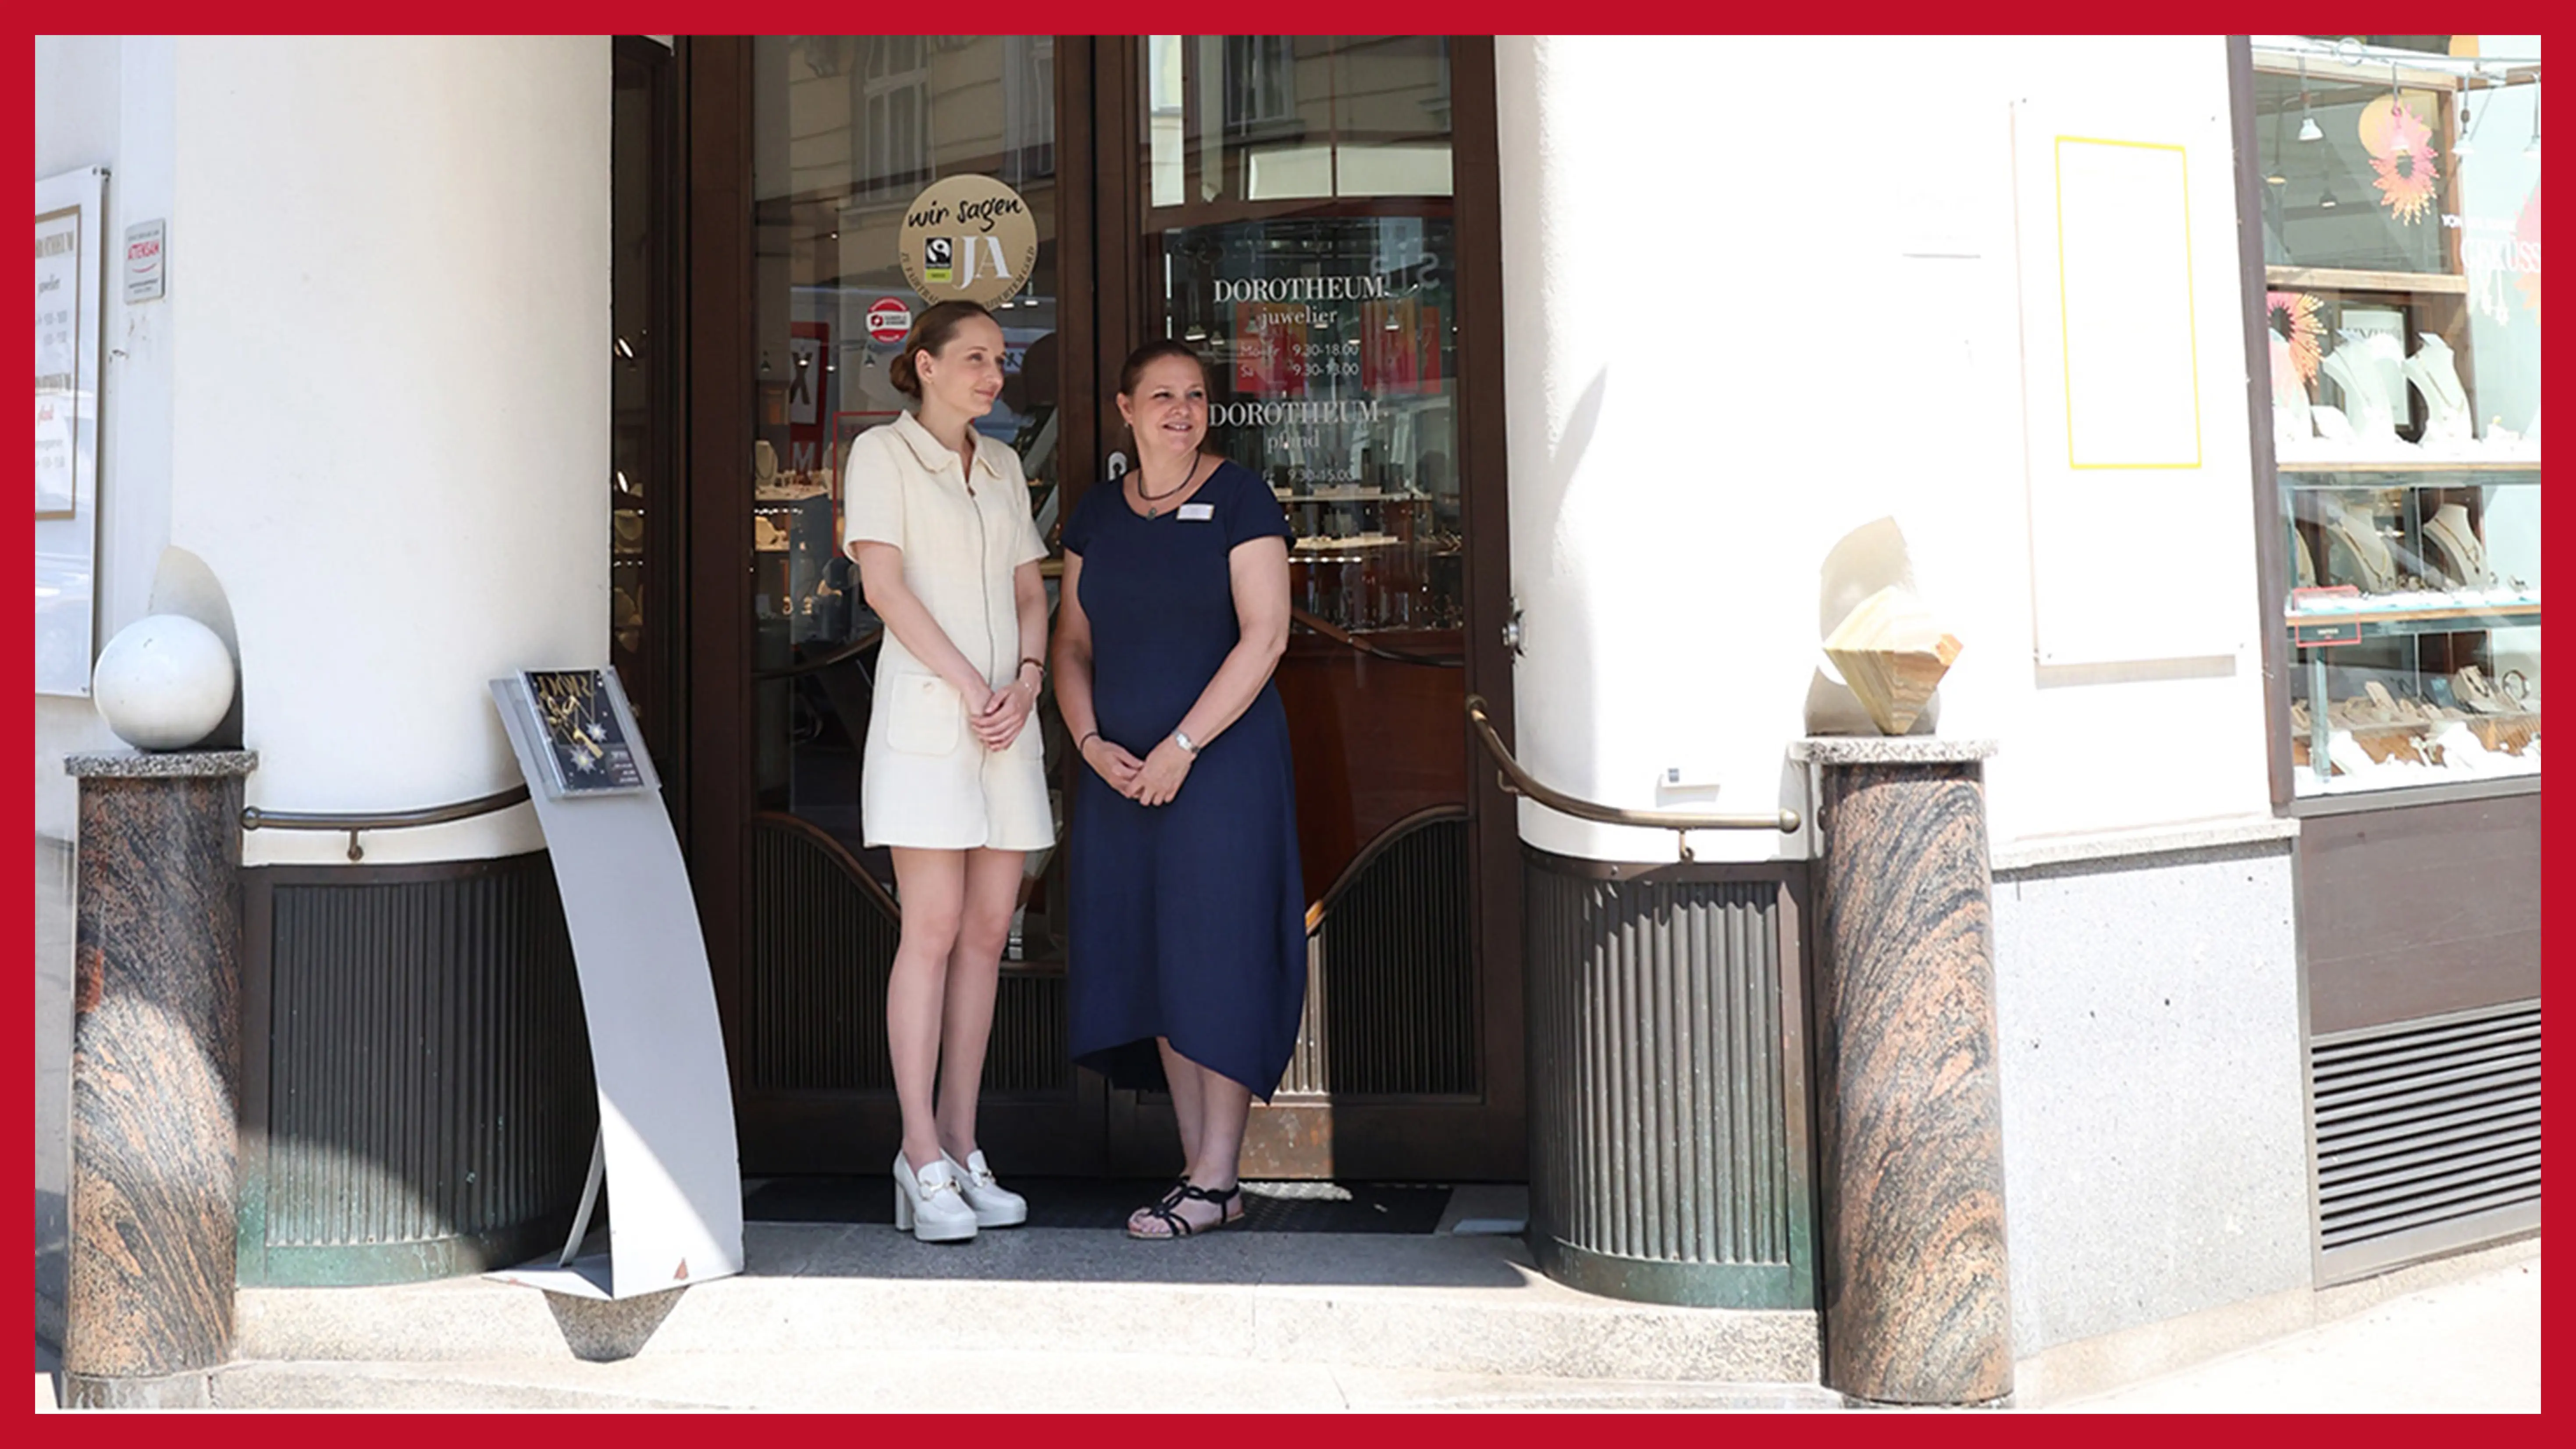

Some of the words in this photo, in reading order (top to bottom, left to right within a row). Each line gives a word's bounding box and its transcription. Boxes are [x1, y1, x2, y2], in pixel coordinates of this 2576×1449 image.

[908, 200, 949, 227] wir
[957, 198, 1022, 232] sagen
[950, 235, 1012, 291] JA
[1213, 276, 1385, 303] DOROTHEUM
[1259, 306, 1338, 329] juwelier
[1209, 400, 1379, 427] DOROTHEUM
